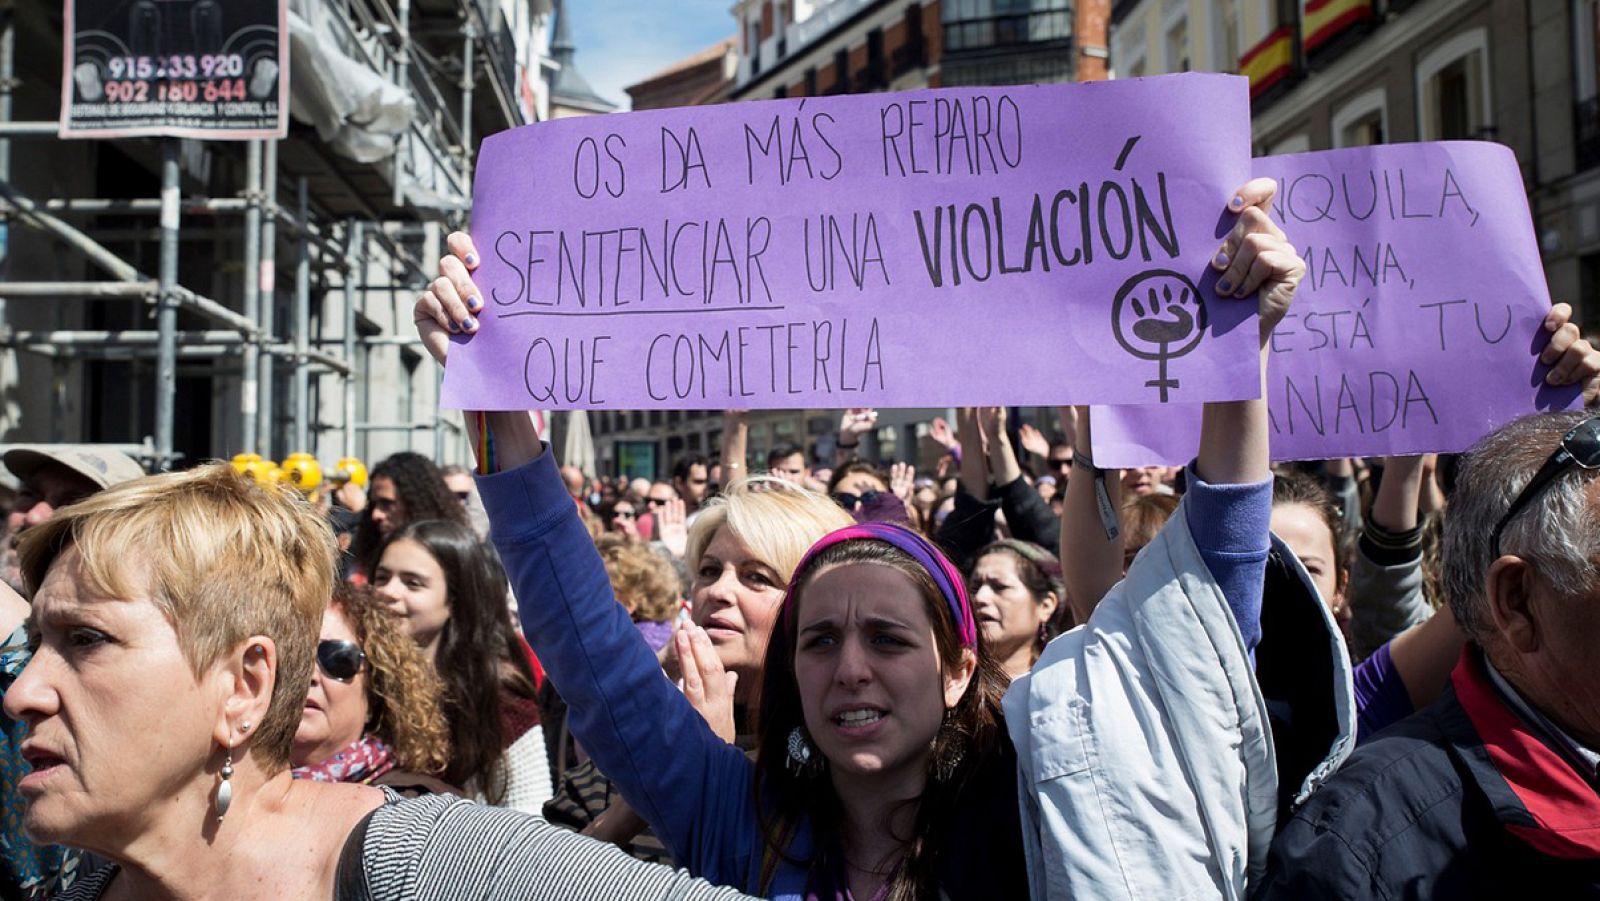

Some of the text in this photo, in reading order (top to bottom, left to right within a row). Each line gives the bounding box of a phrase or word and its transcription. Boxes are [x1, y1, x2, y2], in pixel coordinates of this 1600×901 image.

[105, 80, 148, 102] 902
[204, 79, 246, 101] 644
[109, 55, 152, 79] 915
[201, 53, 243, 77] 920
[573, 94, 1023, 199] OS DA MÁS REPARO
[491, 134, 1181, 308] SENTENCIAR UNA VIOLACIÓN
[1270, 297, 1513, 353] ESTÁ TU
[524, 317, 885, 405] QUE COMETERLA
[1267, 369, 1439, 436] NADA
